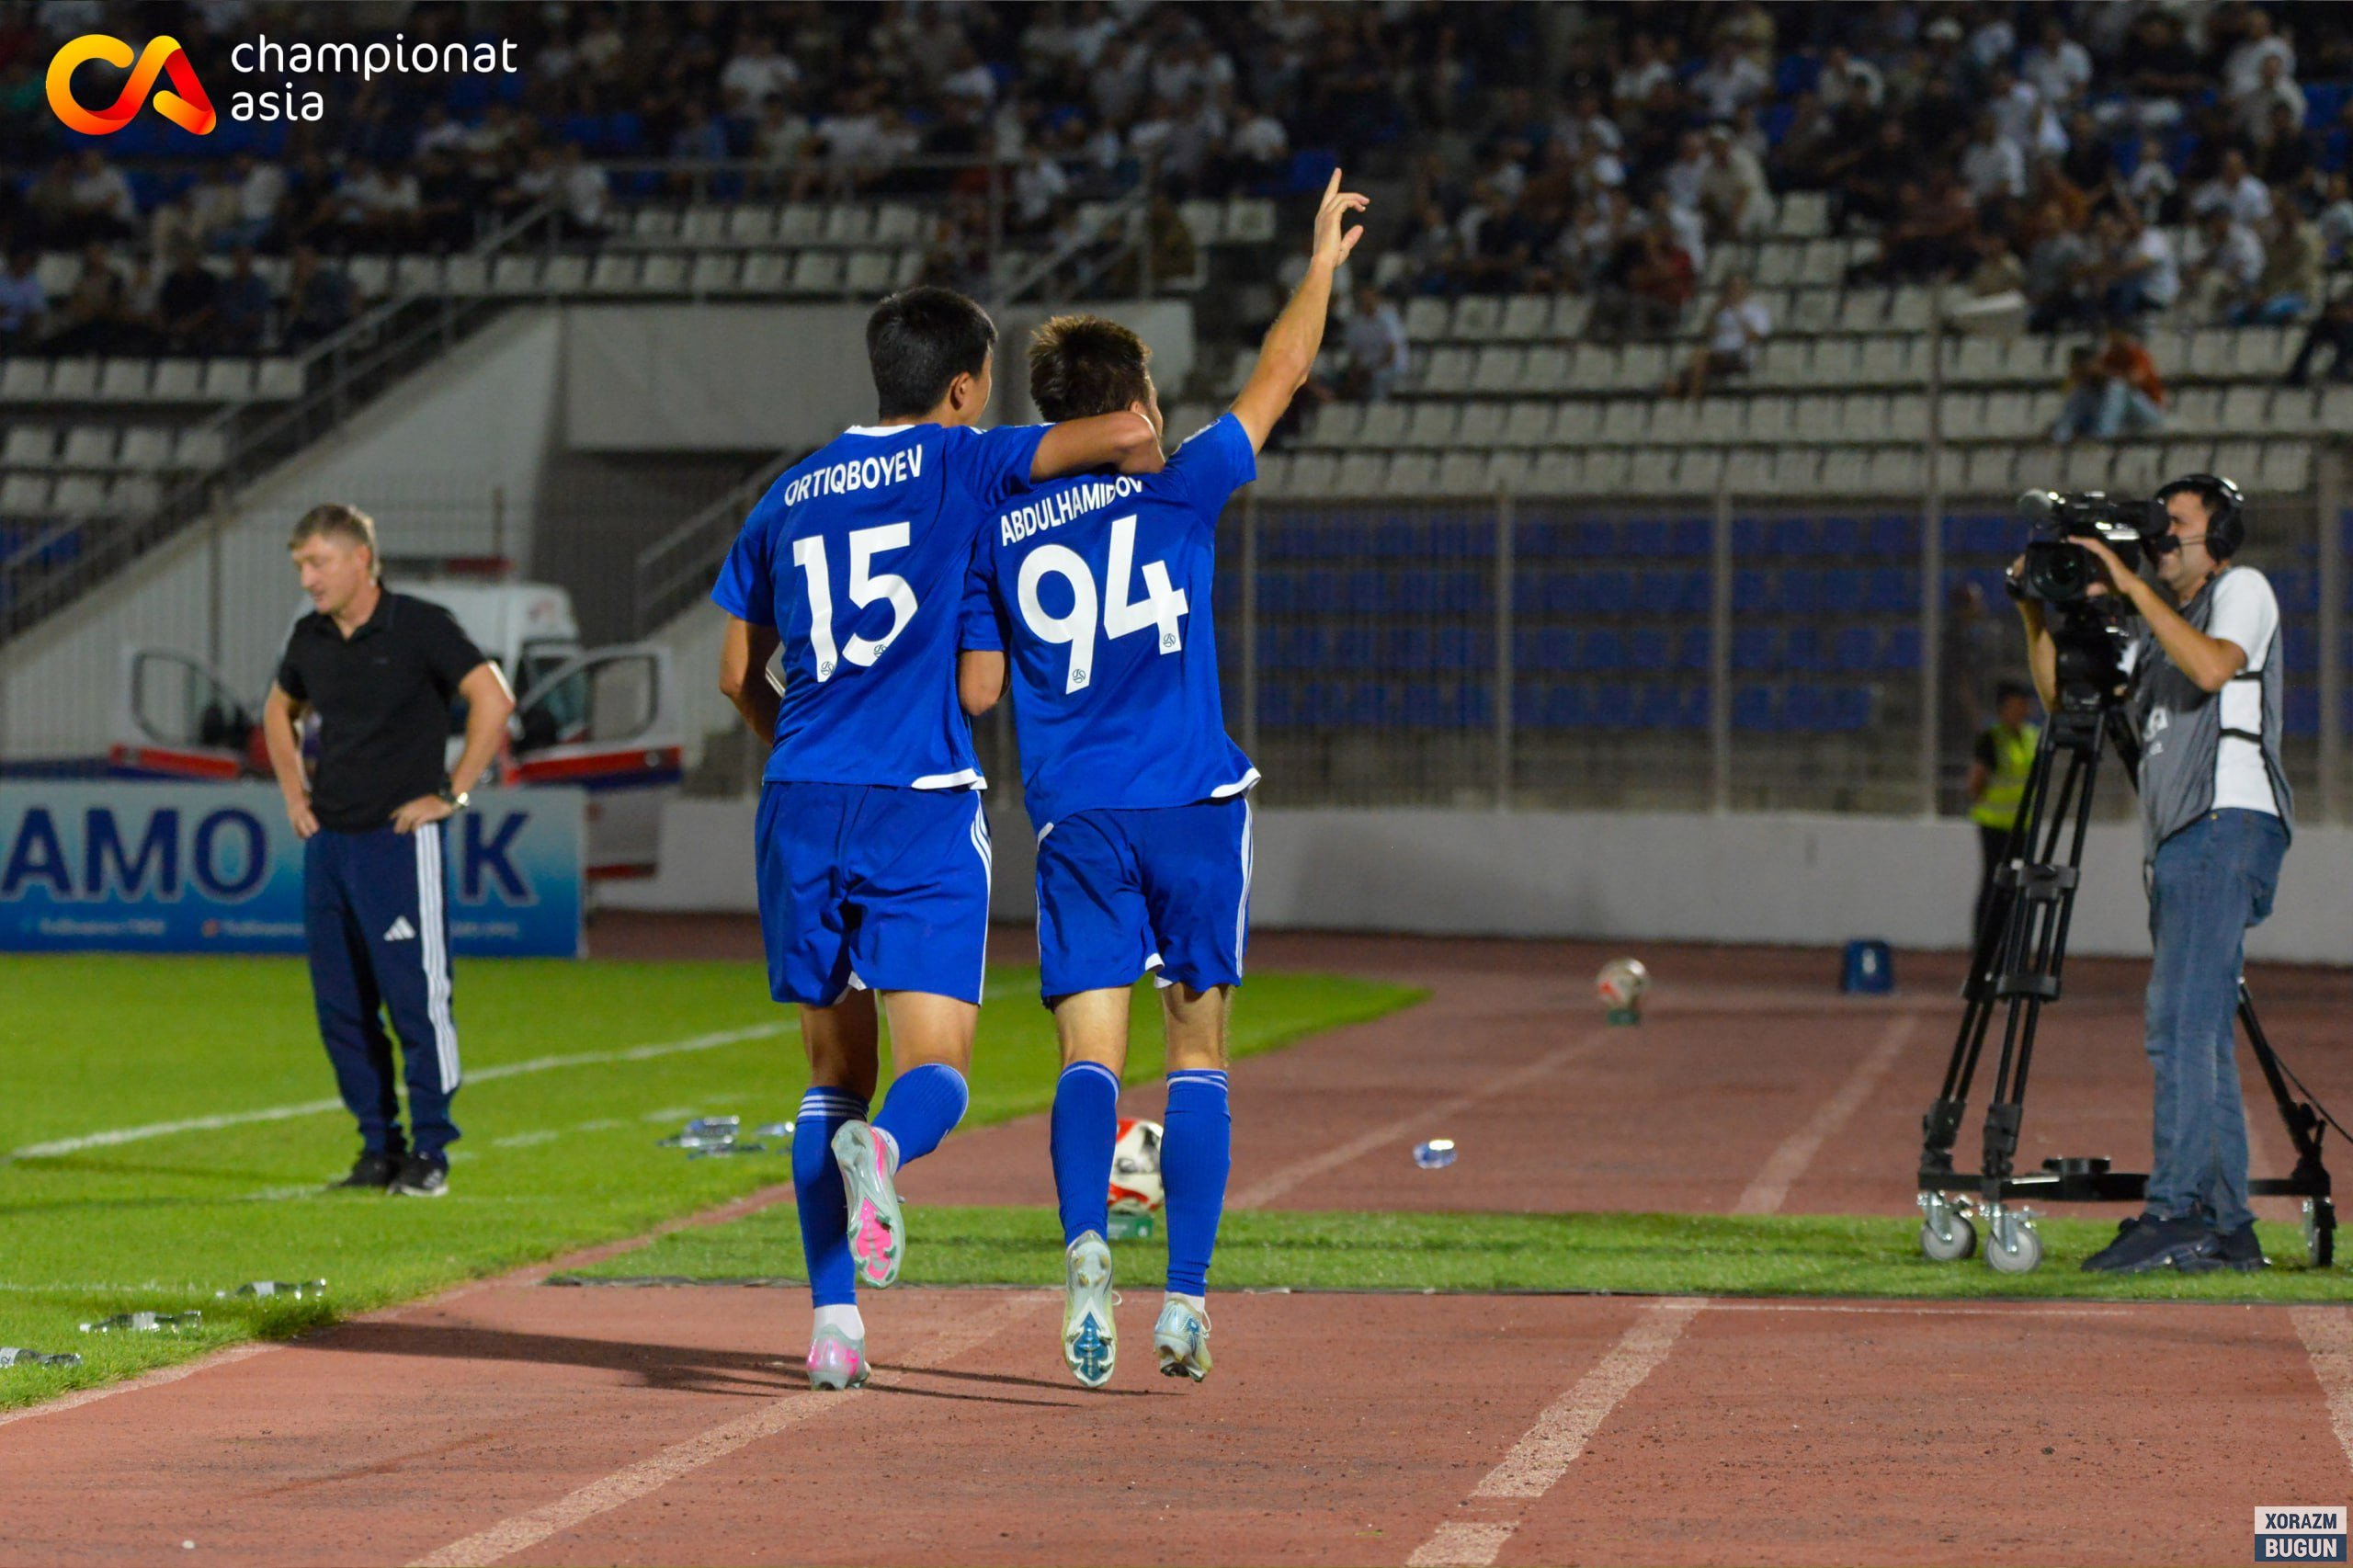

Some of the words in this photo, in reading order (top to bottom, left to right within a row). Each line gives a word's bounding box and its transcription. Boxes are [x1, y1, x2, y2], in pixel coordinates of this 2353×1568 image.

[784, 444, 923, 506] ORTIQBOYEV
[792, 521, 918, 683] 15
[1017, 515, 1188, 695] 94
